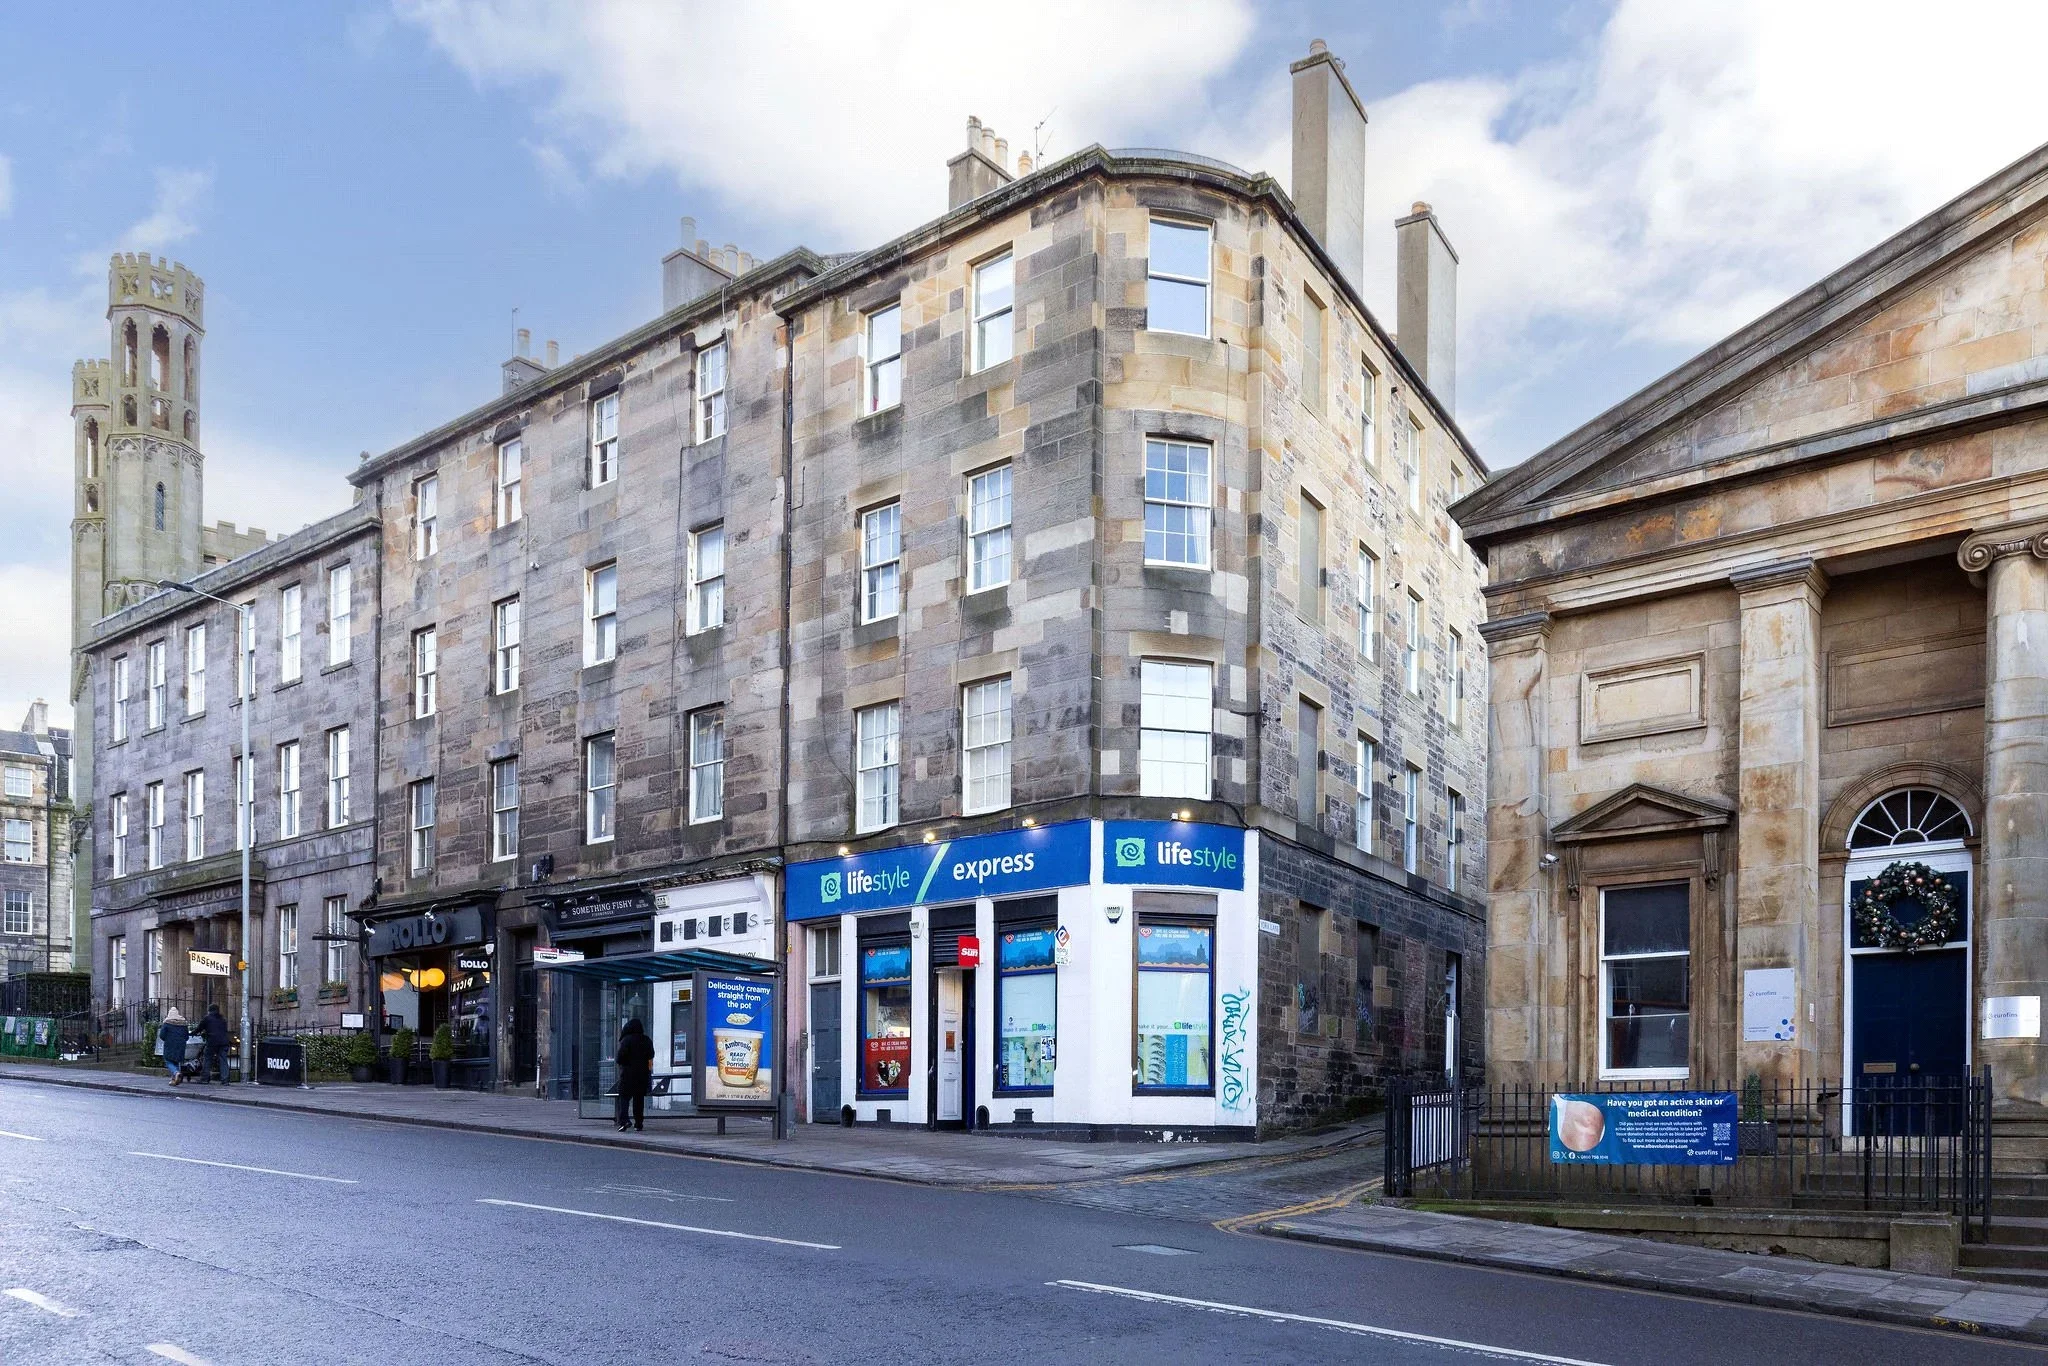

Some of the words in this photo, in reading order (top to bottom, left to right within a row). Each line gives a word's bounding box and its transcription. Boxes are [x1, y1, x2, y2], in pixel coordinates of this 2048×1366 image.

[1157, 841, 1237, 873] lifestyle
[847, 865, 910, 895] lifestyle
[953, 852, 1035, 884] express
[572, 902, 611, 916] SOMETHING
[612, 899, 633, 910] FISHY
[388, 916, 447, 950] ROLLO
[191, 953, 229, 974] BASEMENT
[460, 959, 489, 969] ROLLO
[708, 981, 745, 992] Deliciously
[746, 986, 771, 995] creamy
[717, 992, 744, 1000] straight
[745, 993, 761, 1001] from
[727, 1000, 739, 1008] the
[1181, 1022, 1208, 1031] lifestyle
[724, 1040, 752, 1051] Ambrosia
[267, 1057, 290, 1070] ROLLO
[726, 1061, 750, 1069] Porridge
[1607, 1099, 1627, 1107] Have
[1627, 1100, 1643, 1108] you
[1643, 1099, 1657, 1108] got
[1670, 1098, 1694, 1106] active
[1695, 1098, 1713, 1106] skin
[1628, 1109, 1659, 1117] medical
[1660, 1109, 1703, 1117] condition?
